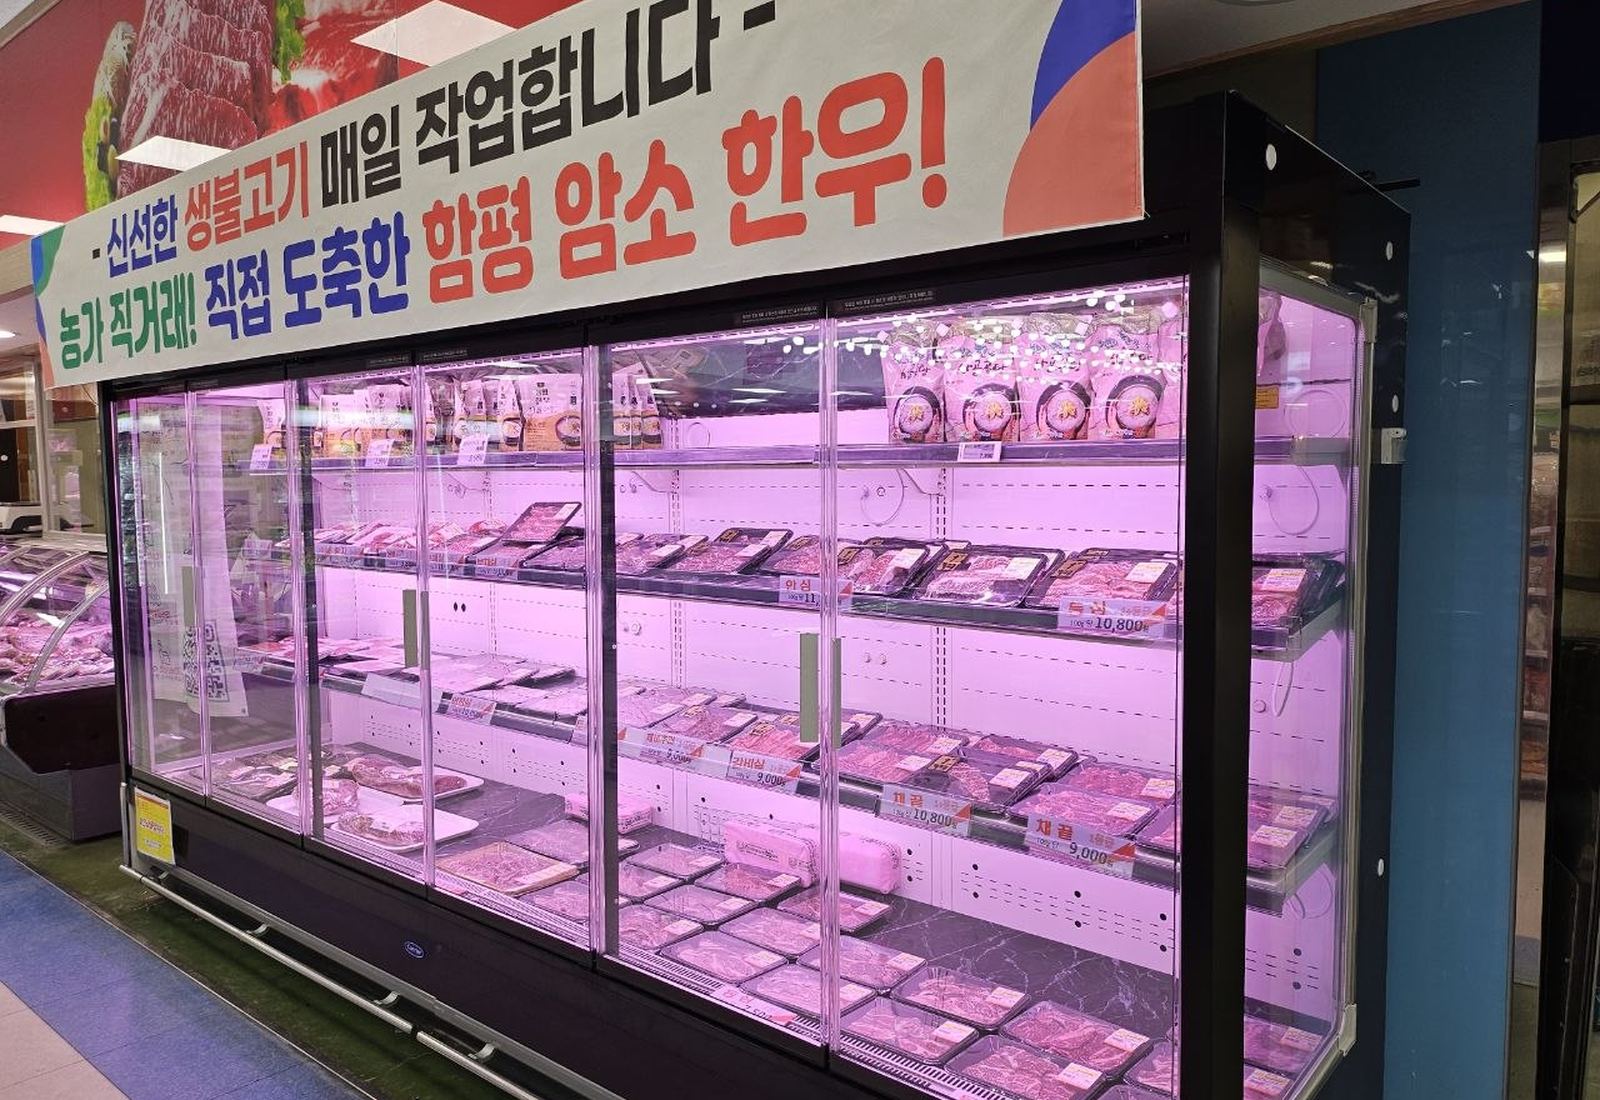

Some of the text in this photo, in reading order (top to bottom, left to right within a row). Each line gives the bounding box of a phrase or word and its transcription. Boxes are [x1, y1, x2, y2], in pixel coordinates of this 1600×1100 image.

[60, 56, 948, 369] 농가 직거래! 직접 도축한 함평 암소 한우!
[107, 194, 178, 278] 신선한
[184, 141, 310, 252] 생불고기
[320, 119, 401, 209] 매일
[415, 0, 720, 174] 작업합니다
